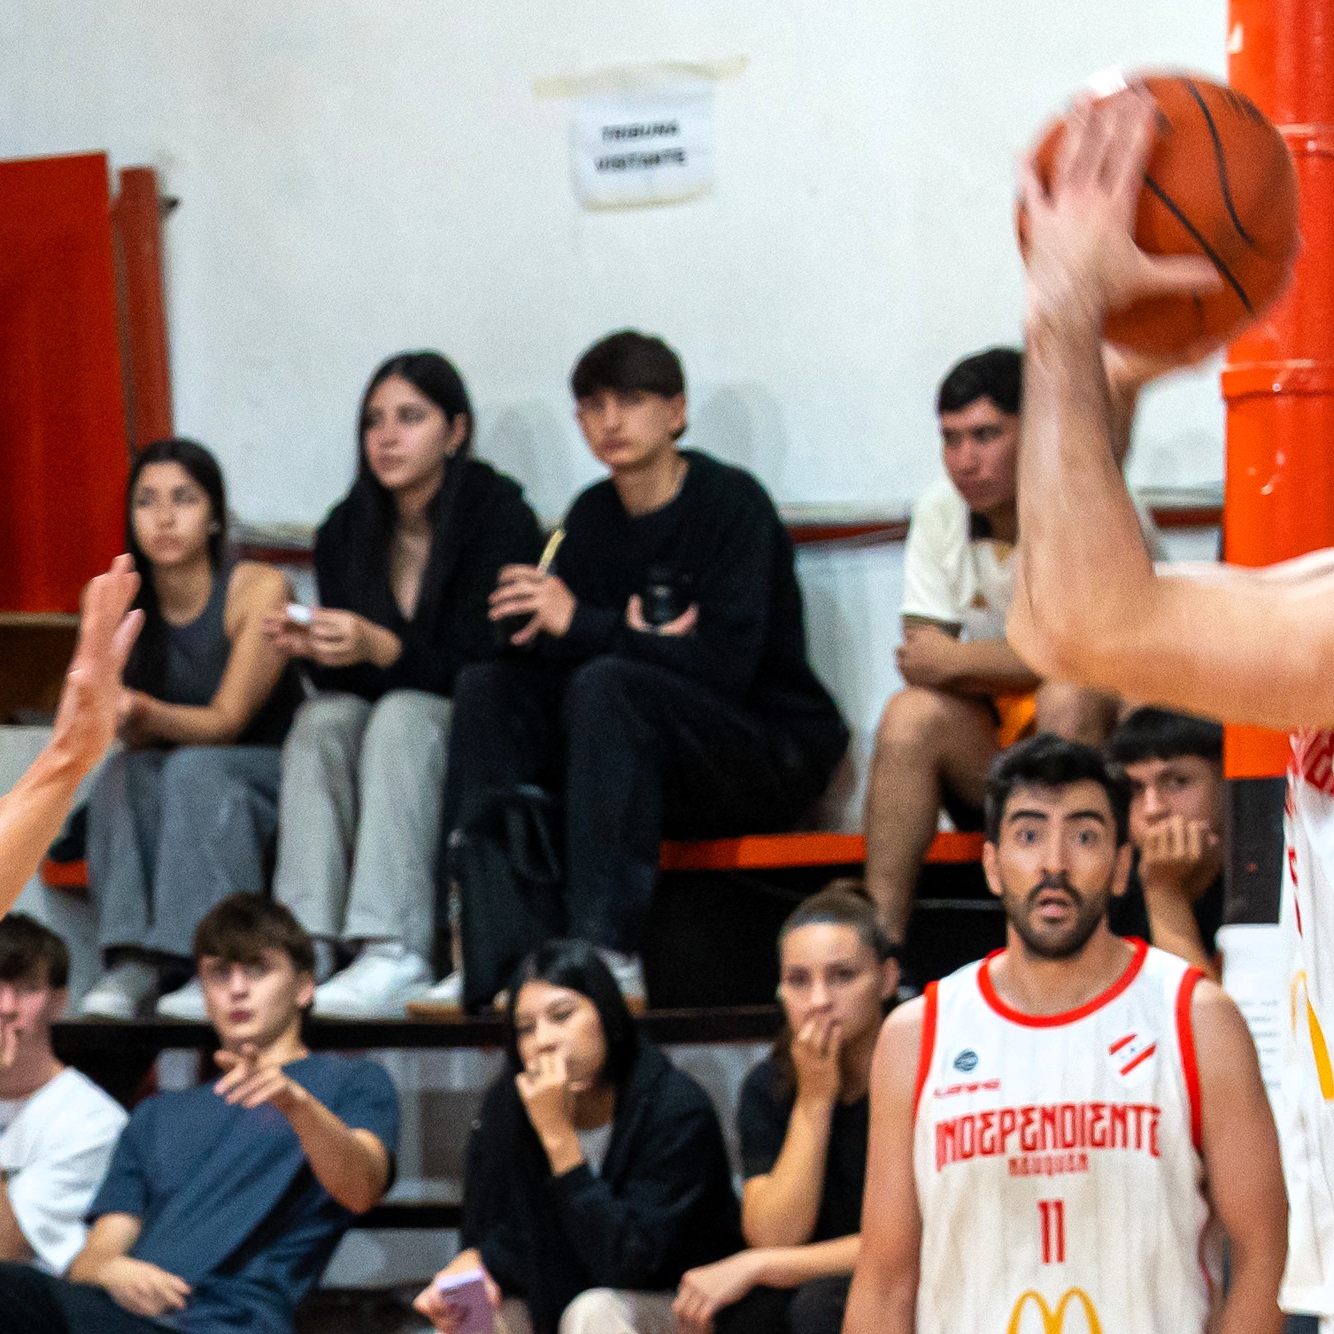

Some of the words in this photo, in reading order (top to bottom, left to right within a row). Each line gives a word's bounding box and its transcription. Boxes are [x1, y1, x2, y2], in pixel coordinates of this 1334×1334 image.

[602, 120, 681, 142] TRIBUNA
[595, 147, 687, 174] VISITANTE
[935, 1102, 1161, 1173] INDEPENDIENTE
[1037, 1199, 1065, 1265] 11
